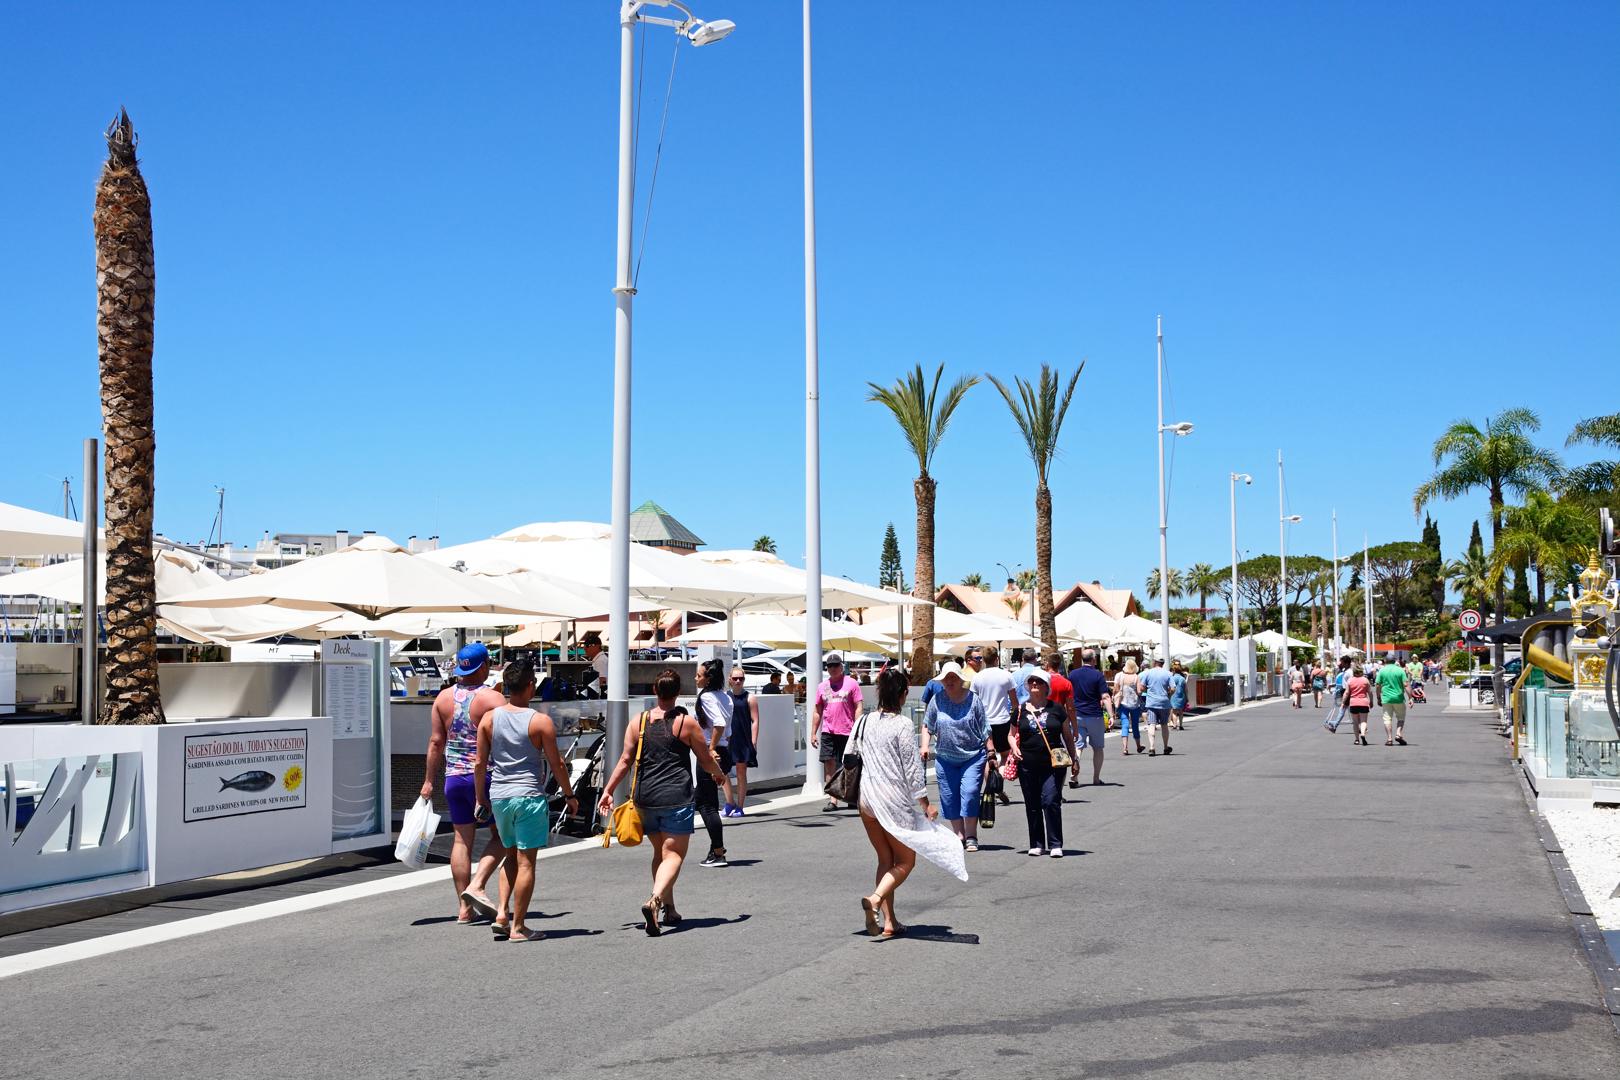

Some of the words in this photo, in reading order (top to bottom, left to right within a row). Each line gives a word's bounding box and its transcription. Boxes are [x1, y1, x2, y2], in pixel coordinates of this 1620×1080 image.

[333, 642, 351, 655] Deck
[187, 740, 221, 757] SUGESTÃO
[222, 742, 231, 754] DO
[232, 741, 243, 753] DIA
[247, 738, 273, 752] TODAY'S
[273, 737, 305, 750] SUGESTION
[187, 760, 214, 769] SARDINHA
[214, 758, 234, 767] ASSADA
[234, 757, 246, 765] COM
[247, 756, 265, 764] BATATA
[265, 755, 279, 763] FRITA
[279, 754, 286, 762] OU
[286, 753, 304, 761] COZIDA
[192, 804, 215, 814] GRILLED
[215, 801, 240, 811] SARDINES
[268, 796, 279, 804] NEW
